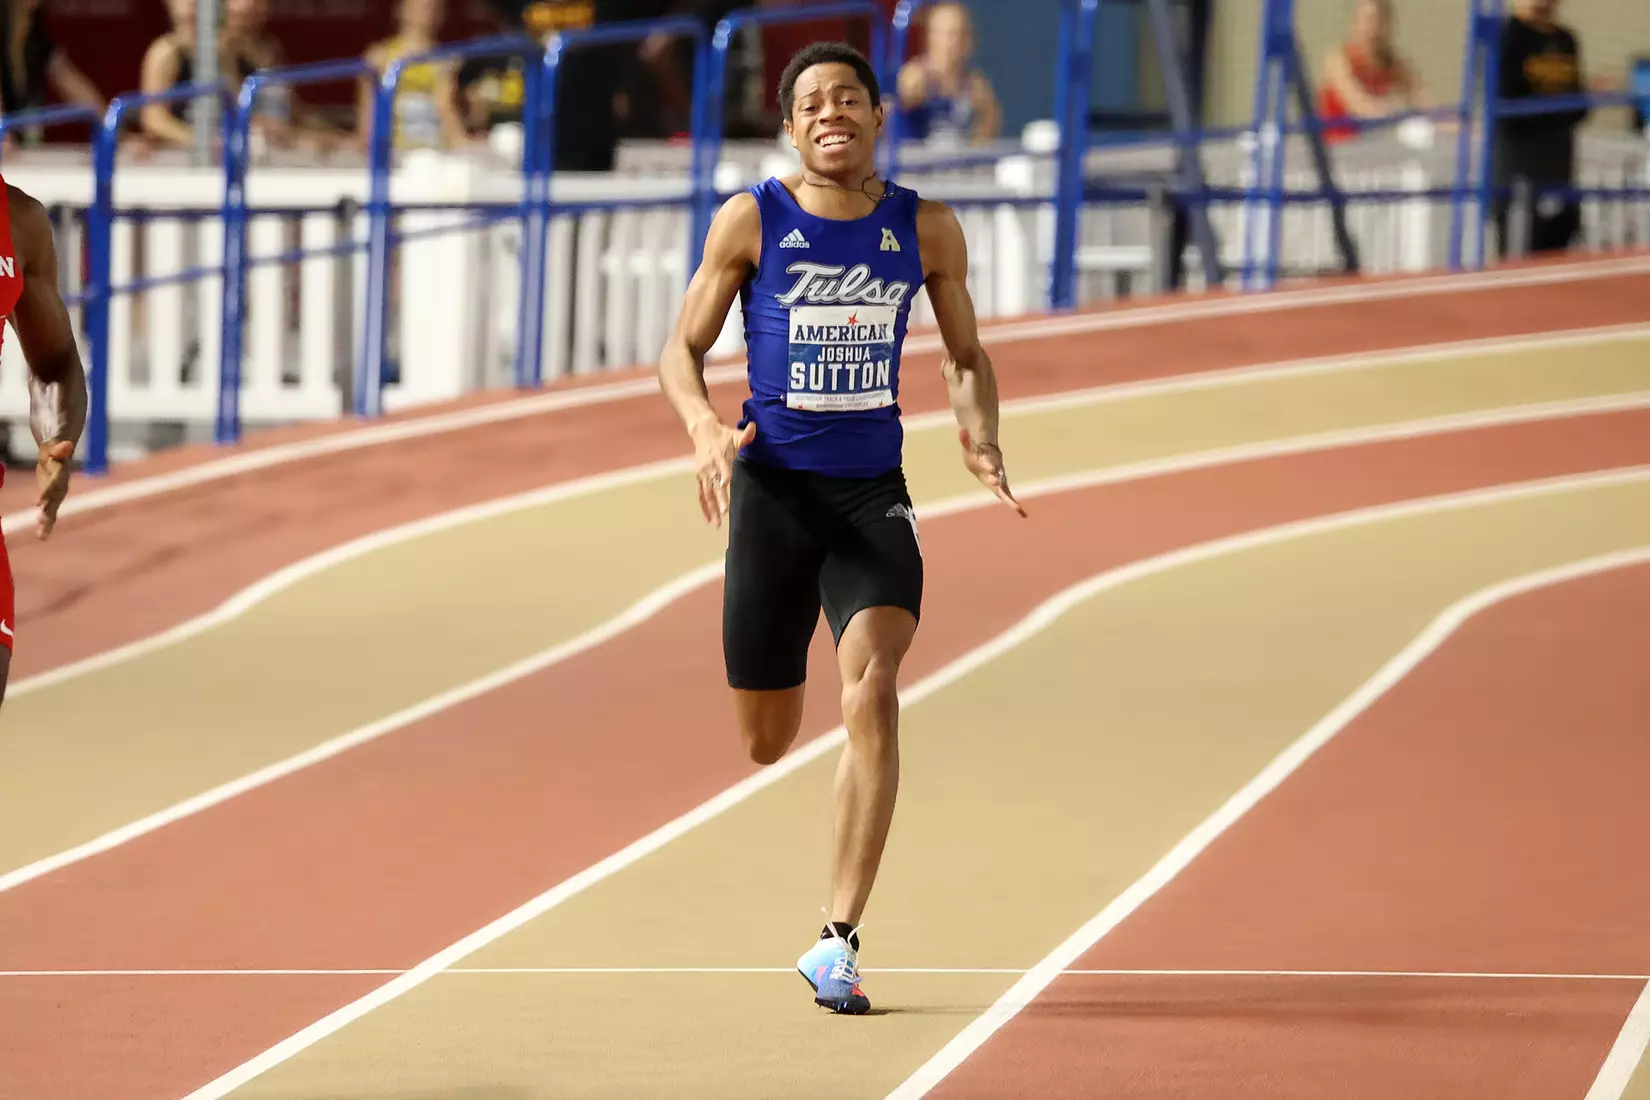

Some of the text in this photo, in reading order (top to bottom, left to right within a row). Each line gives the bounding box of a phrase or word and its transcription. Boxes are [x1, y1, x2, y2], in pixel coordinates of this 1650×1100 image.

[779, 240, 810, 249] adidas
[880, 227, 901, 252] A
[775, 261, 911, 307] Tulsa
[794, 324, 888, 341] AMERICAN
[817, 346, 871, 362] JOSHUA
[790, 358, 890, 391] SUTTON
